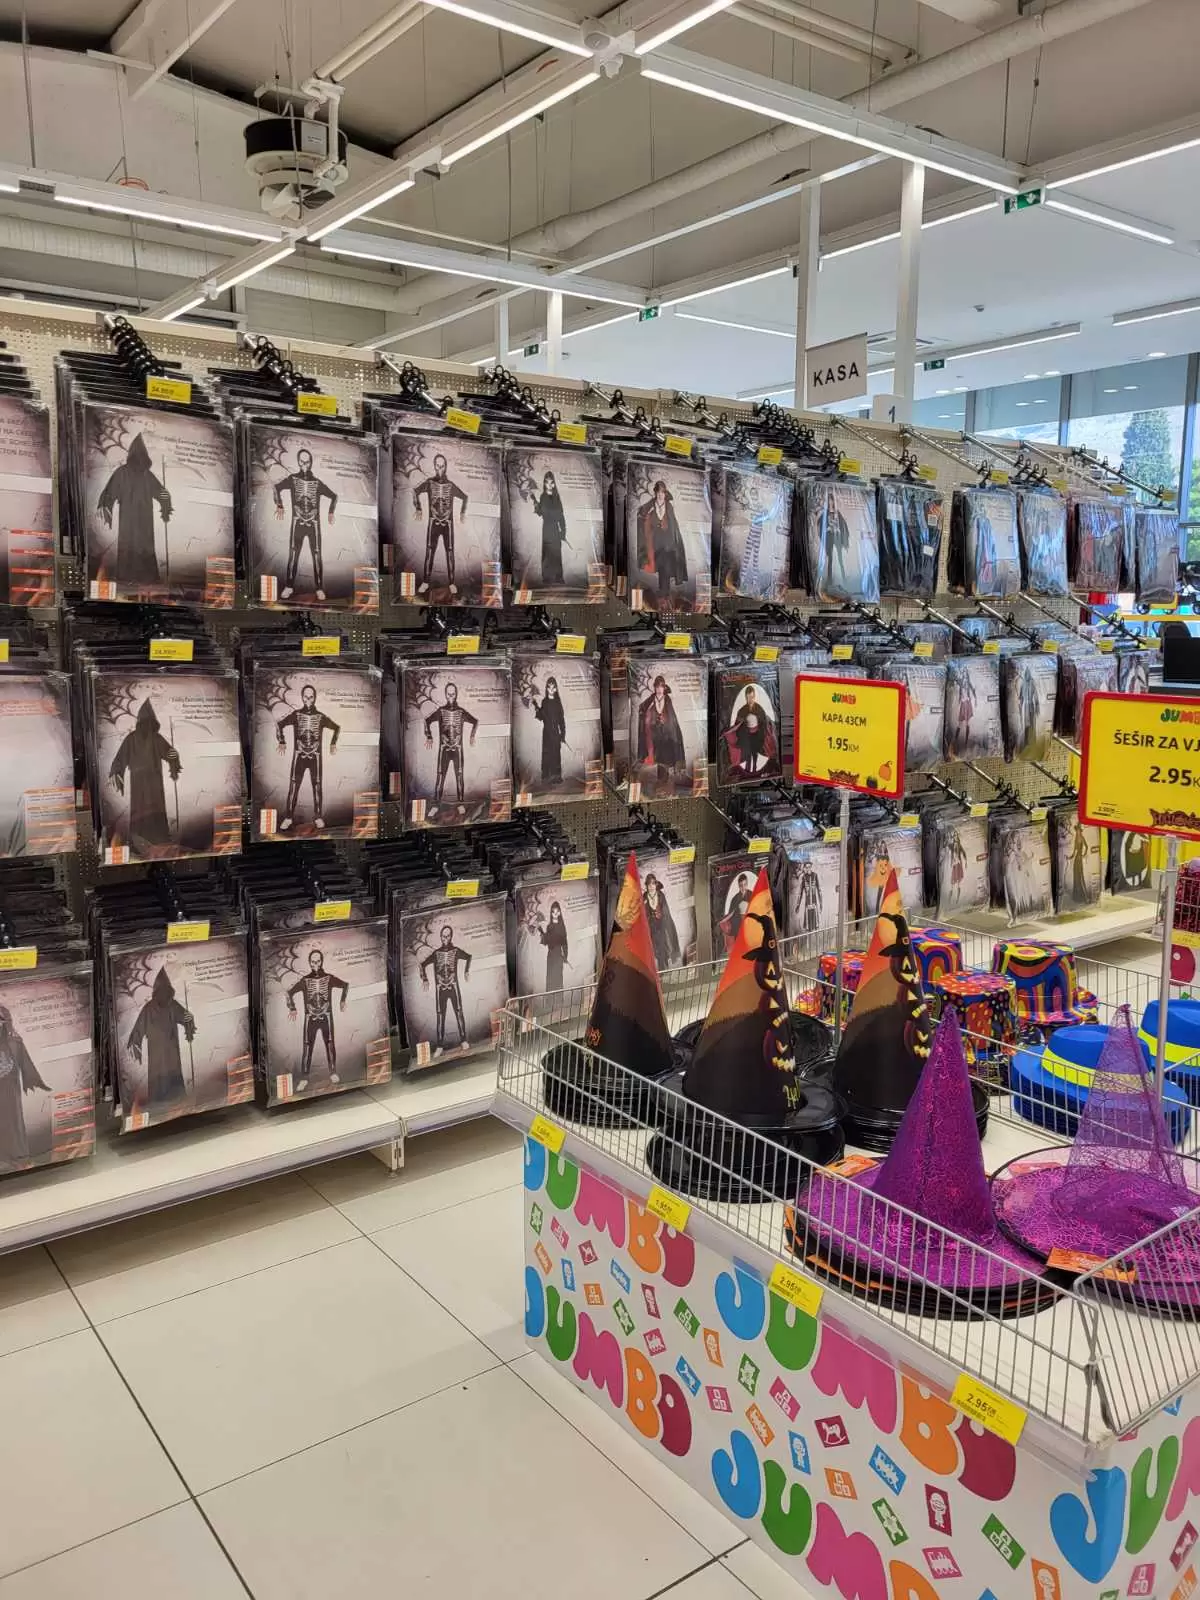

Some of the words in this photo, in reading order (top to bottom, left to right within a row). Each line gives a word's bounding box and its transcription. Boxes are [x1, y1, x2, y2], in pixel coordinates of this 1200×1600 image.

[813, 361, 860, 387] KASA
[888, 405, 896, 423] 1
[821, 711, 844, 723] KAPA
[845, 715, 867, 727] 43CM
[1113, 729, 1155, 748] ŠEŠIR
[1157, 736, 1179, 750] ZA
